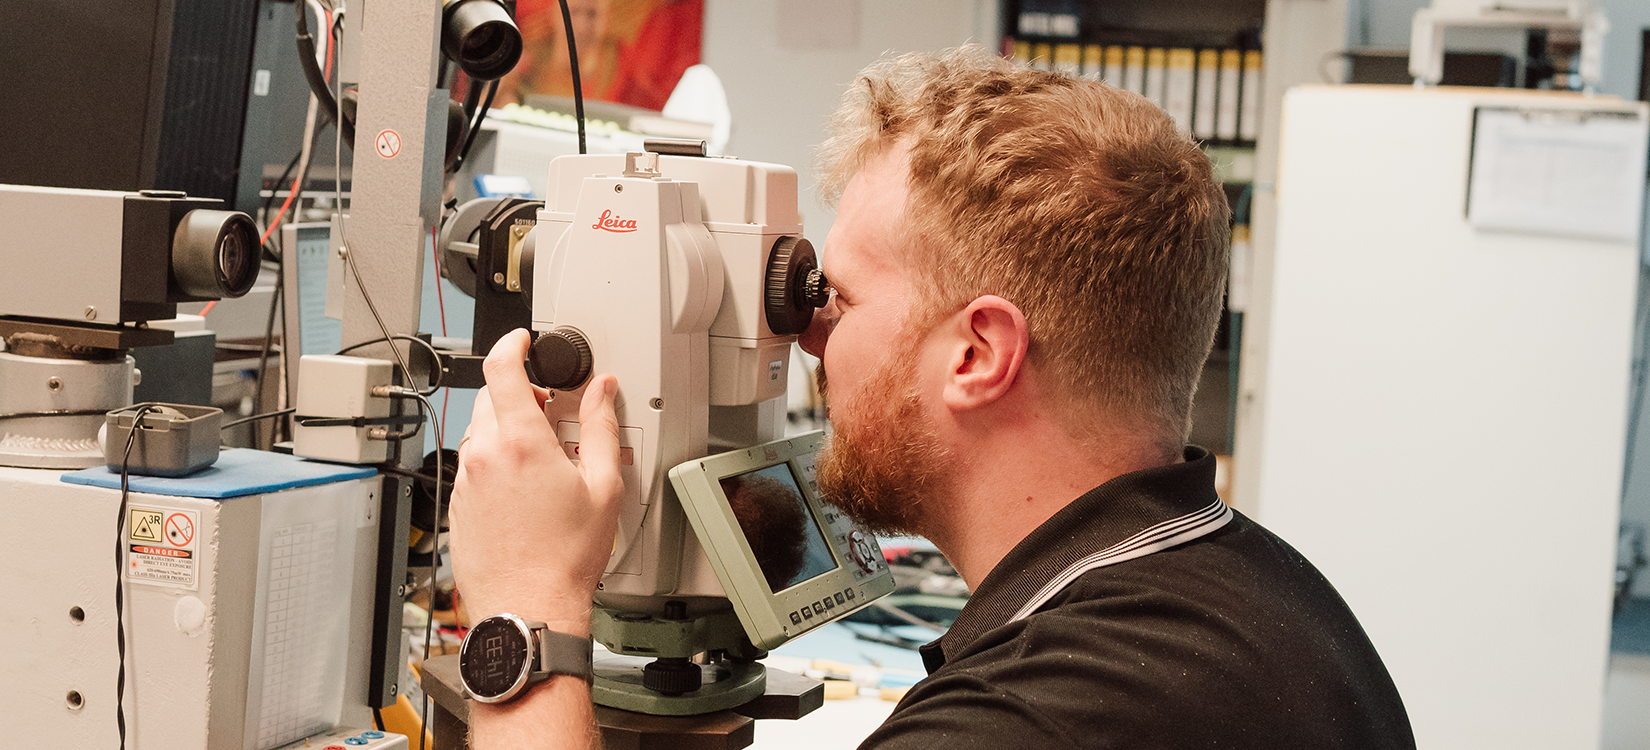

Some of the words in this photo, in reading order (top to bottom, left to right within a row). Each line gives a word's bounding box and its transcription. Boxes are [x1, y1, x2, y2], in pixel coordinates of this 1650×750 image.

[592, 209, 638, 233] Leica
[148, 514, 160, 525] 3R
[143, 547, 179, 556] DANGER
